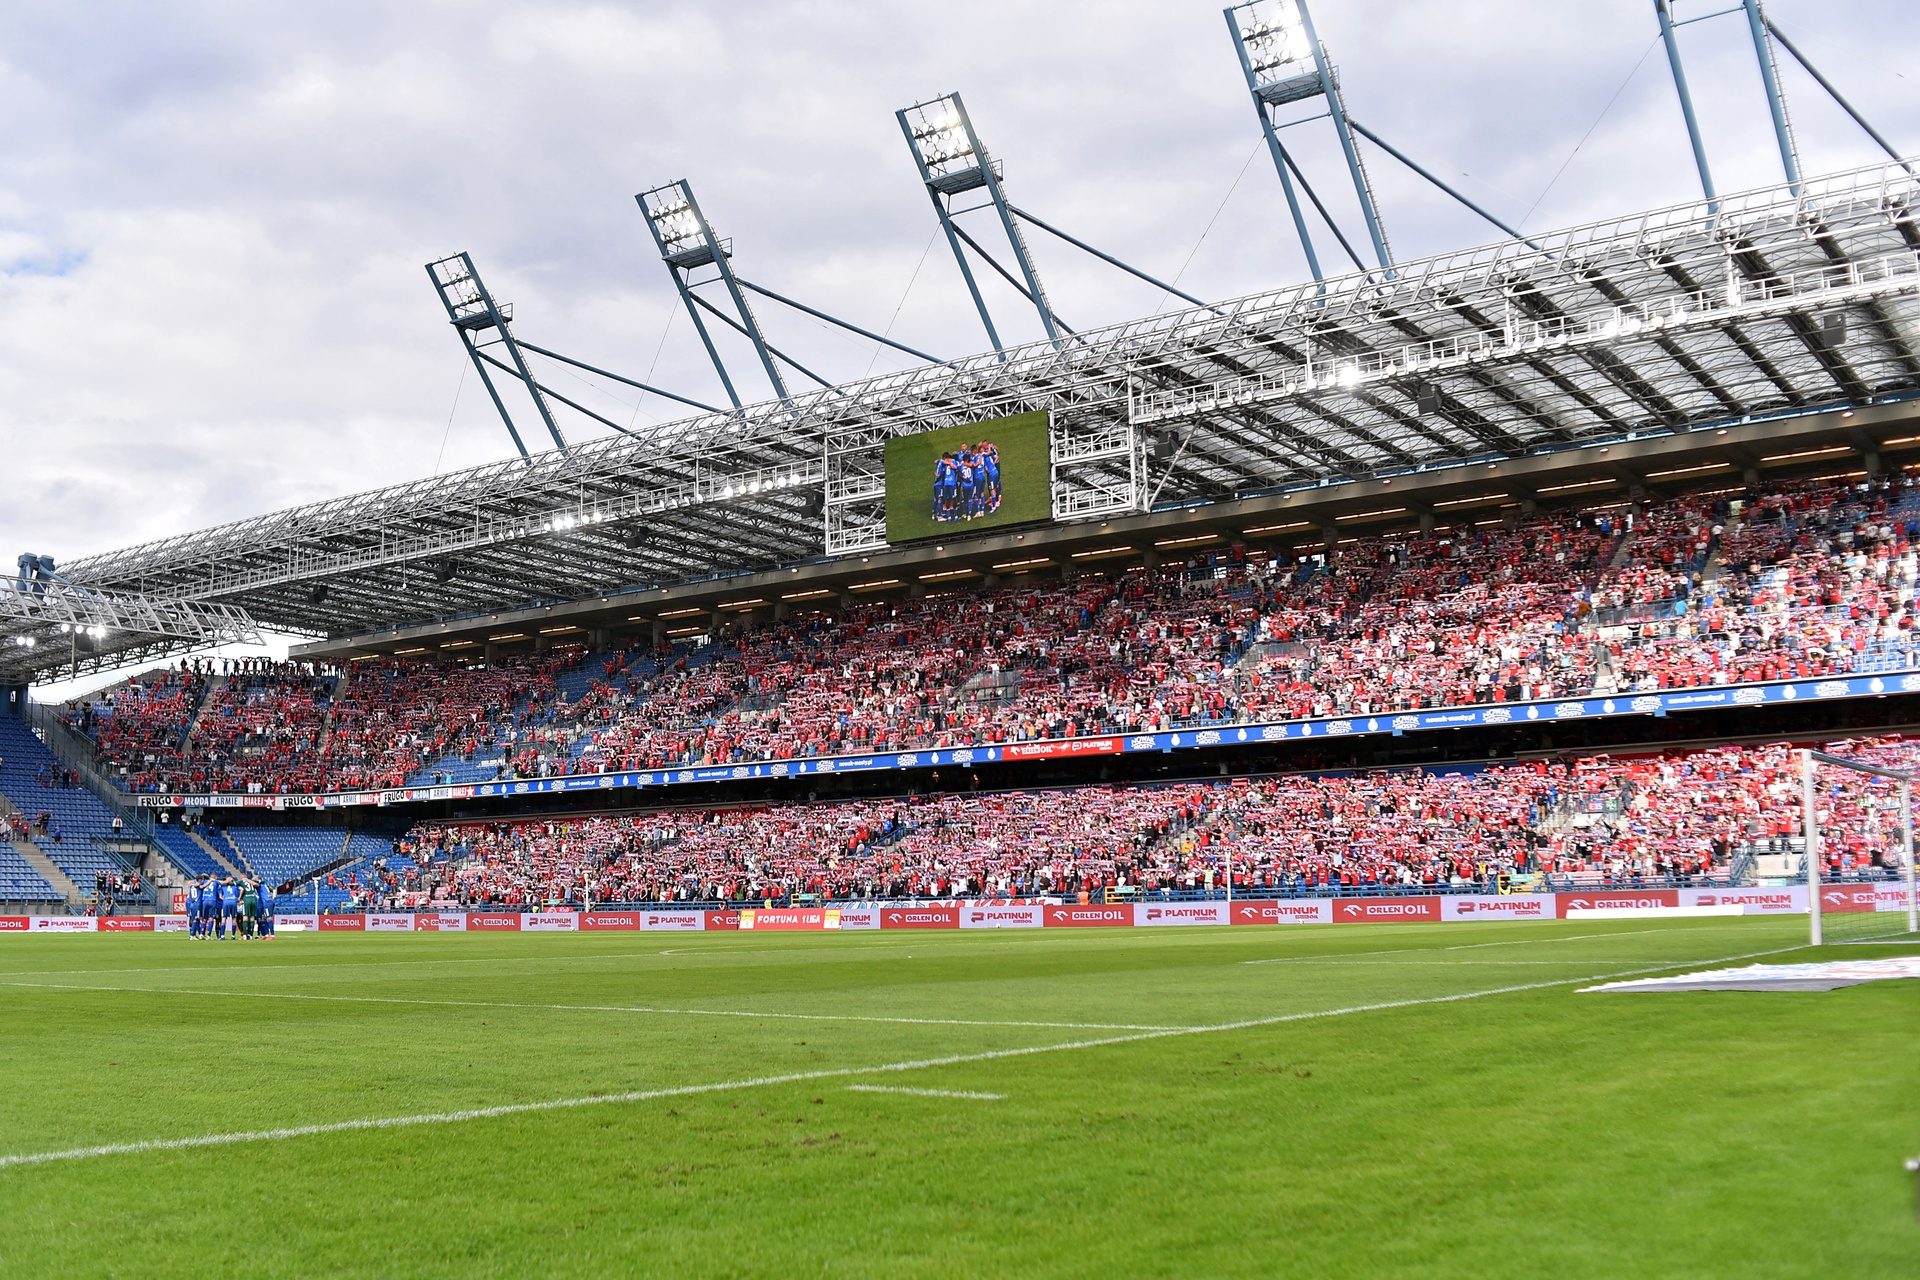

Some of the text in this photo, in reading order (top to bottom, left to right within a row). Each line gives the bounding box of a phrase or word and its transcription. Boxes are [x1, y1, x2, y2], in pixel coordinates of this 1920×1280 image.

[962, 467, 972, 479] 30
[1083, 741, 1112, 749] PLATINUM
[141, 796, 172, 807] FRUGO
[283, 796, 313, 807] FRUGO
[384, 791, 404, 803] FRUGO
[227, 886, 233, 895] 4
[1721, 895, 1792, 905] PLATINUM
[1369, 904, 1429, 915] ORLEN OIL
[1479, 902, 1541, 910] PLATINUM
[1101, 911, 1124, 920] OIL
[1165, 909, 1216, 917] PLATINUM
[1278, 907, 1318, 915] ATINUM
[757, 915, 798, 924] FORTUNA
[933, 914, 951, 922] OIL
[987, 912, 1032, 920] PLATINUM
